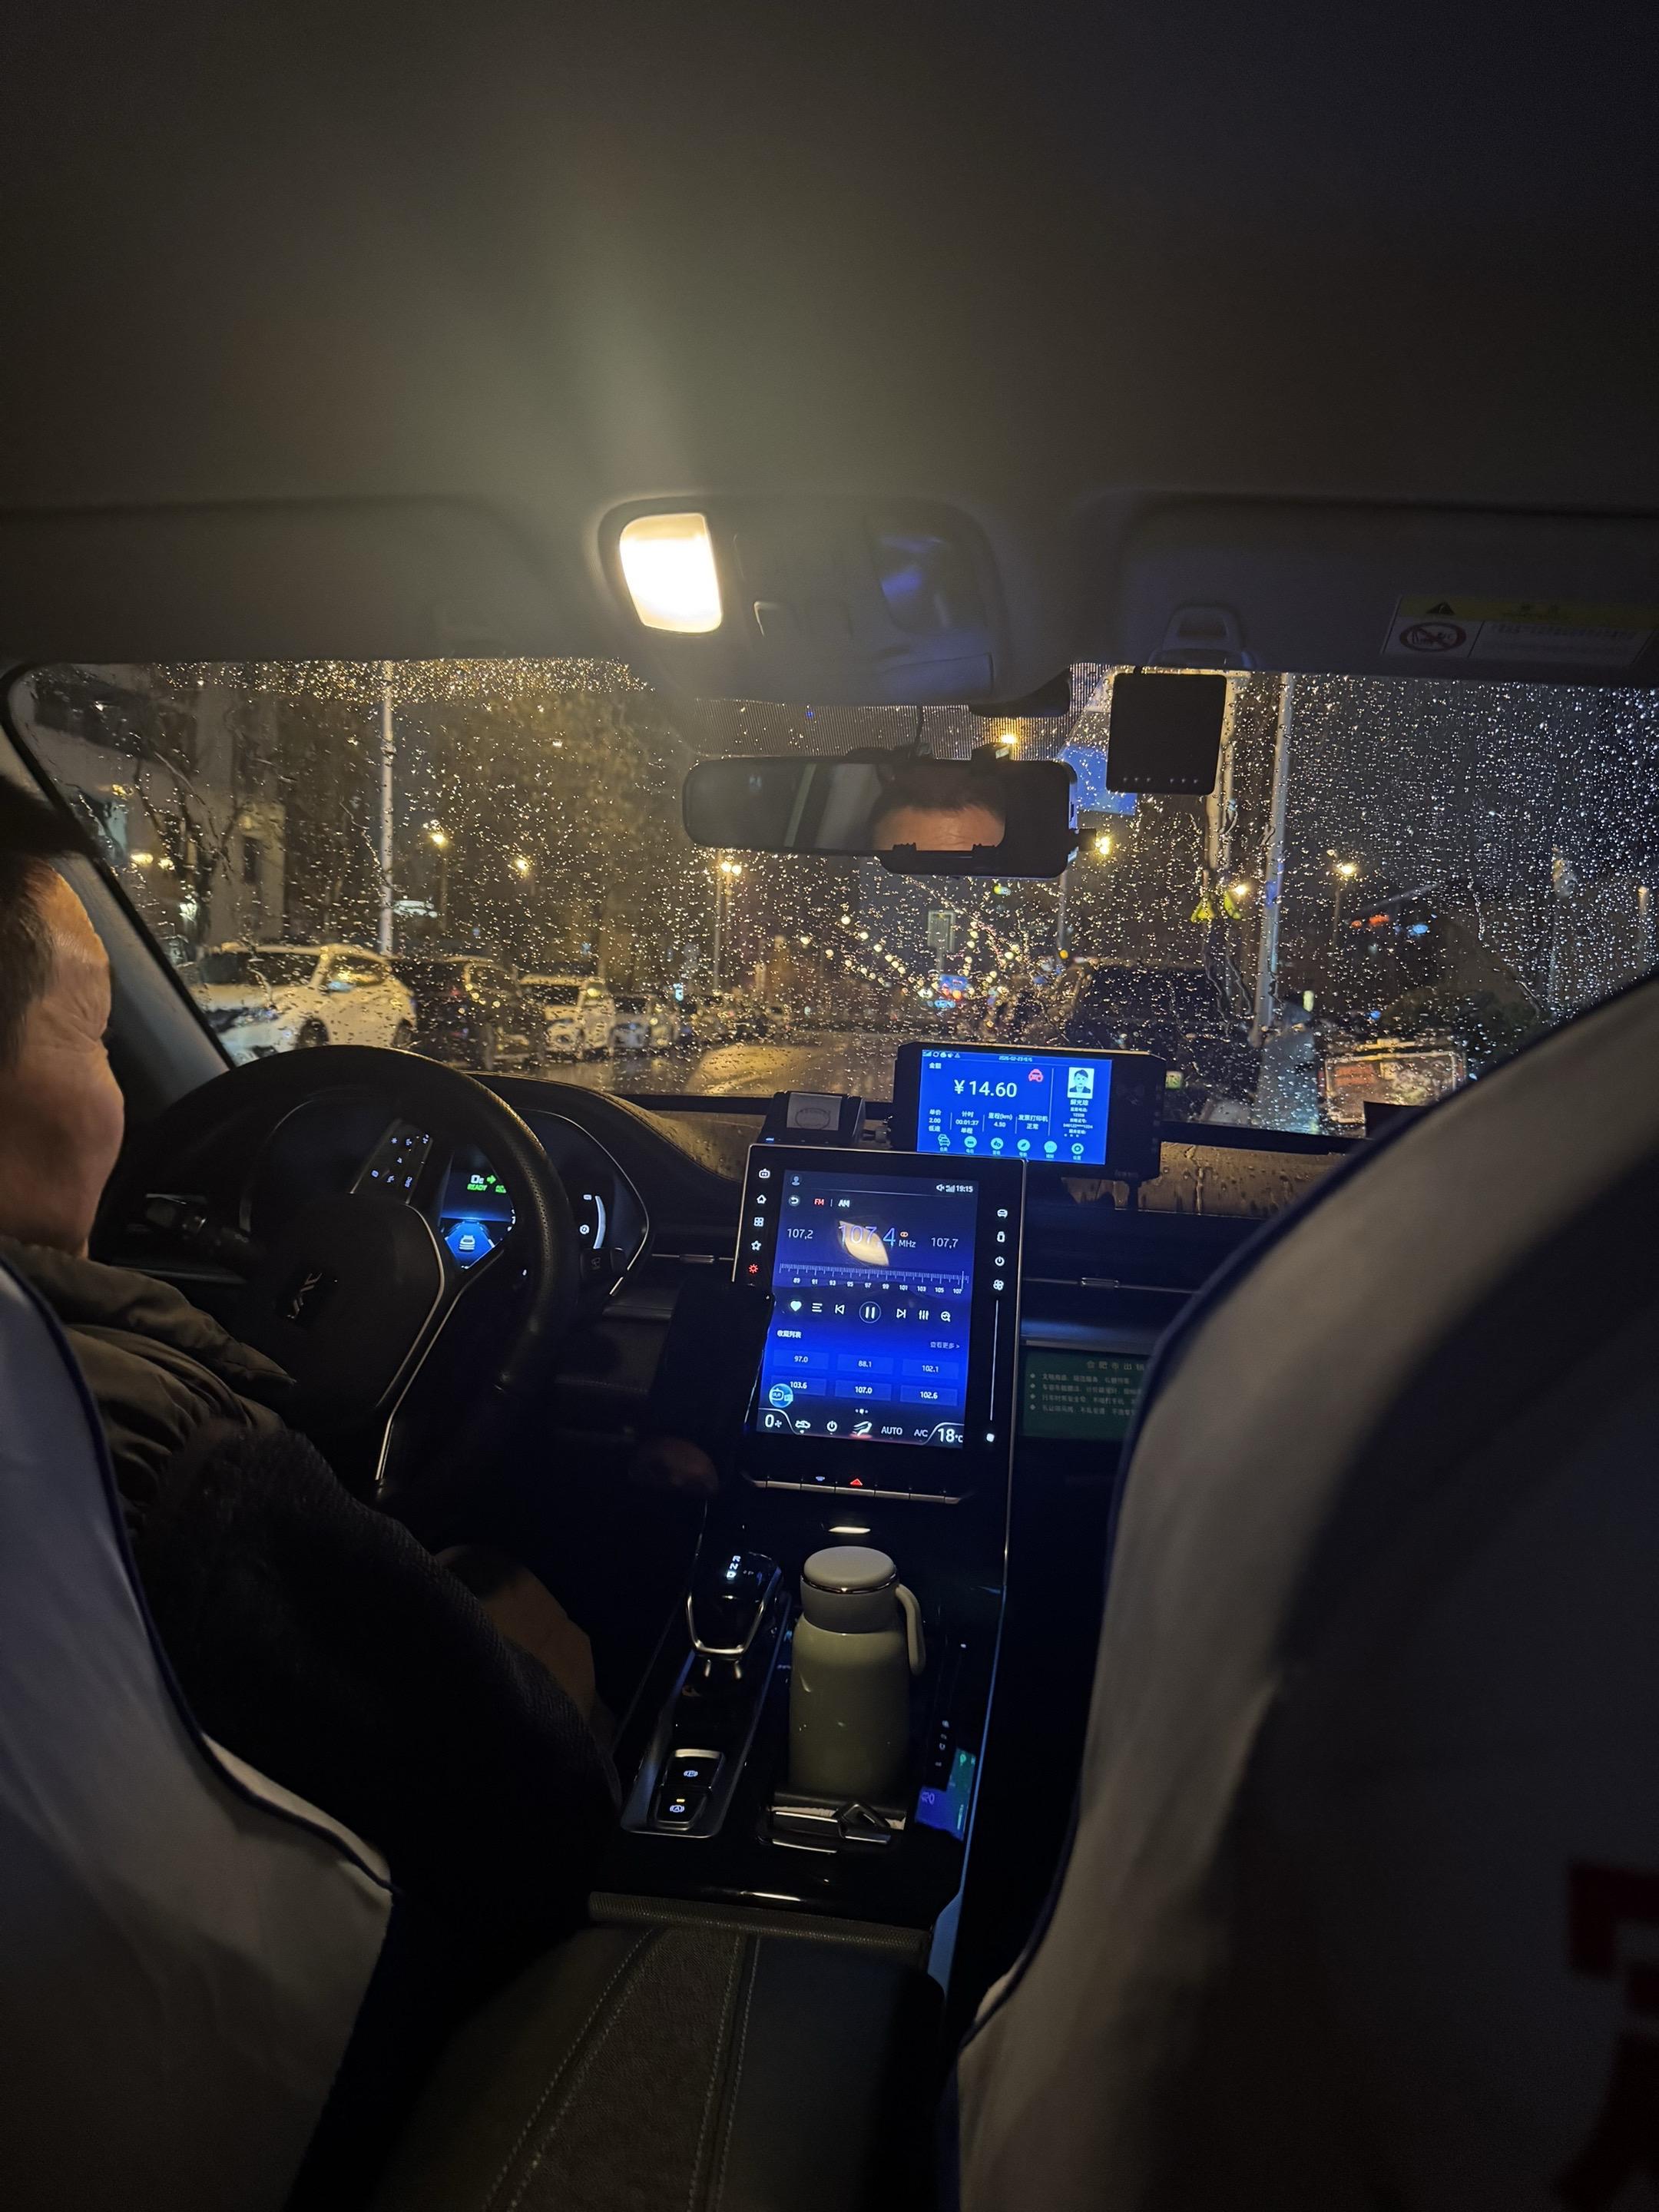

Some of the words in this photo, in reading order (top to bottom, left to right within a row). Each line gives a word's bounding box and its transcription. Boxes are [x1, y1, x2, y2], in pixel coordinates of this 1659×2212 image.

[838, 1199, 850, 1207] AM
[899, 1239, 916, 1248] MHz
[790, 1381, 807, 1389] 103.6
[919, 1391, 938, 1399] 102.6
[881, 1426, 902, 1435] AUTO
[914, 1429, 929, 1438] A/C
